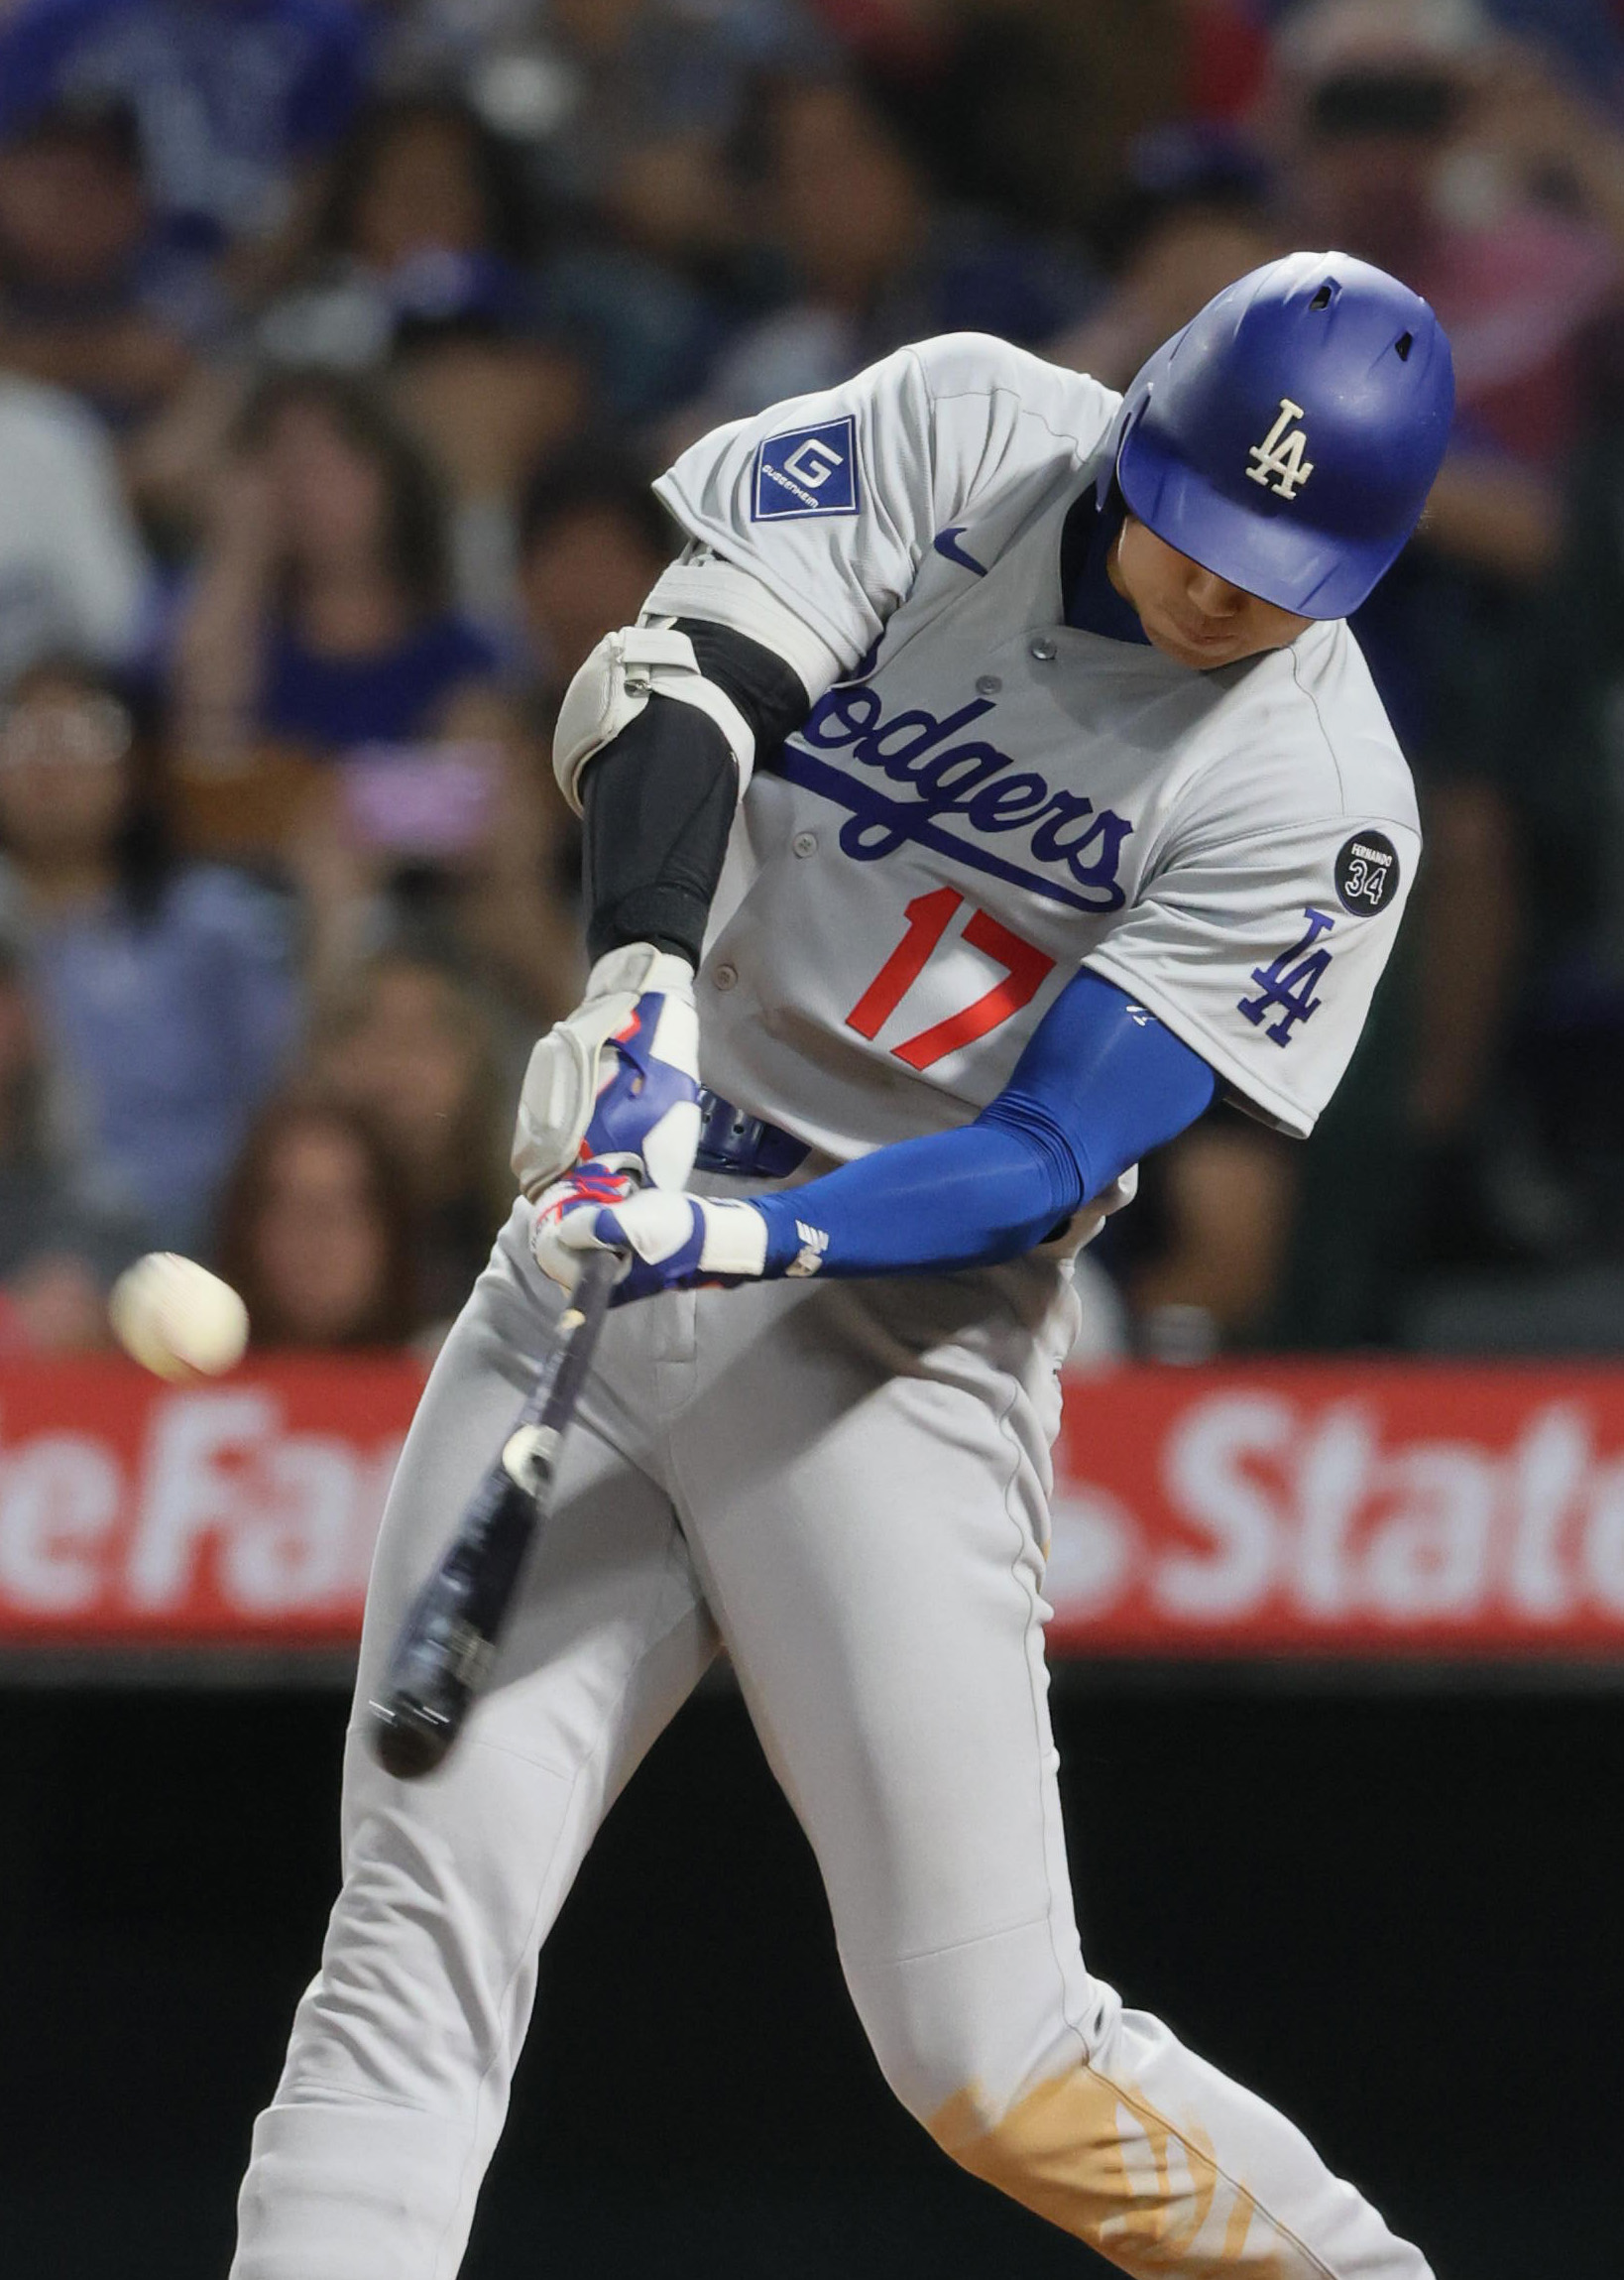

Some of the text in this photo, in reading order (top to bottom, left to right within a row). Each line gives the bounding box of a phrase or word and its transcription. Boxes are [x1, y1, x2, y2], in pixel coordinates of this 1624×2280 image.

[1245, 399, 1314, 500] LA
[801, 686, 1134, 904] odgers
[1350, 843, 1393, 868] FERNANDO
[1344, 859, 1387, 904] 34
[845, 885, 1058, 1071] 17
[1236, 906, 1335, 1048] LA
